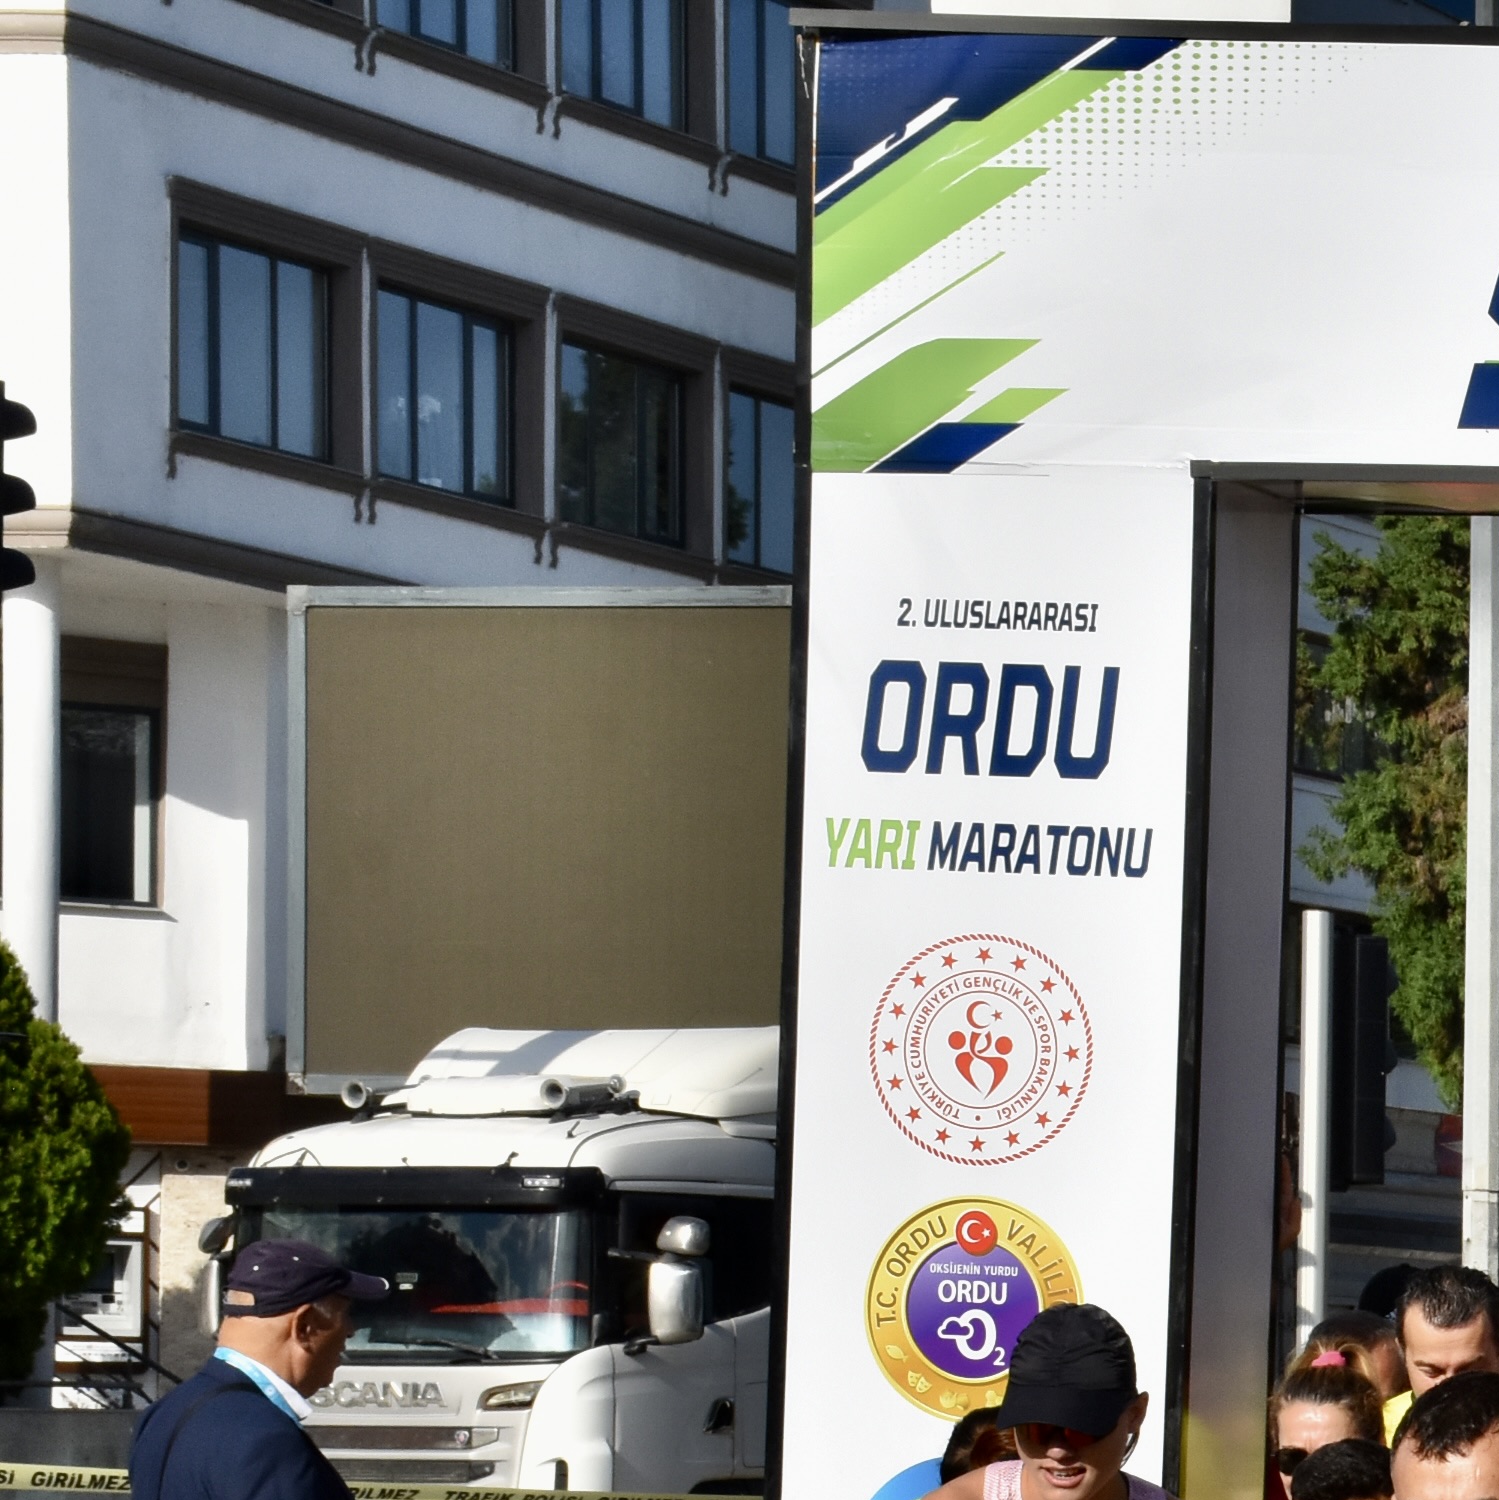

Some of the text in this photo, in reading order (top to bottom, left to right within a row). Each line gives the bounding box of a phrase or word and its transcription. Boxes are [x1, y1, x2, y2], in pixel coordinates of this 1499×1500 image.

[897, 597, 1099, 633] 2. ULUSLARARASI
[860, 658, 1121, 780] ORDU
[825, 816, 1153, 879] YARI MARATONU
[910, 976, 1051, 1120] TÜRKİYE CUMHURİYETİ GENÇLİK VE SPOR BAKANLIĞI
[876, 1213, 948, 1330] T.C. ORDU
[928, 1260, 1018, 1277] OKSİJENİN YURDU
[937, 1279, 1008, 1305] ORDU
[30, 1470, 131, 1491] GİRİLMEZ
